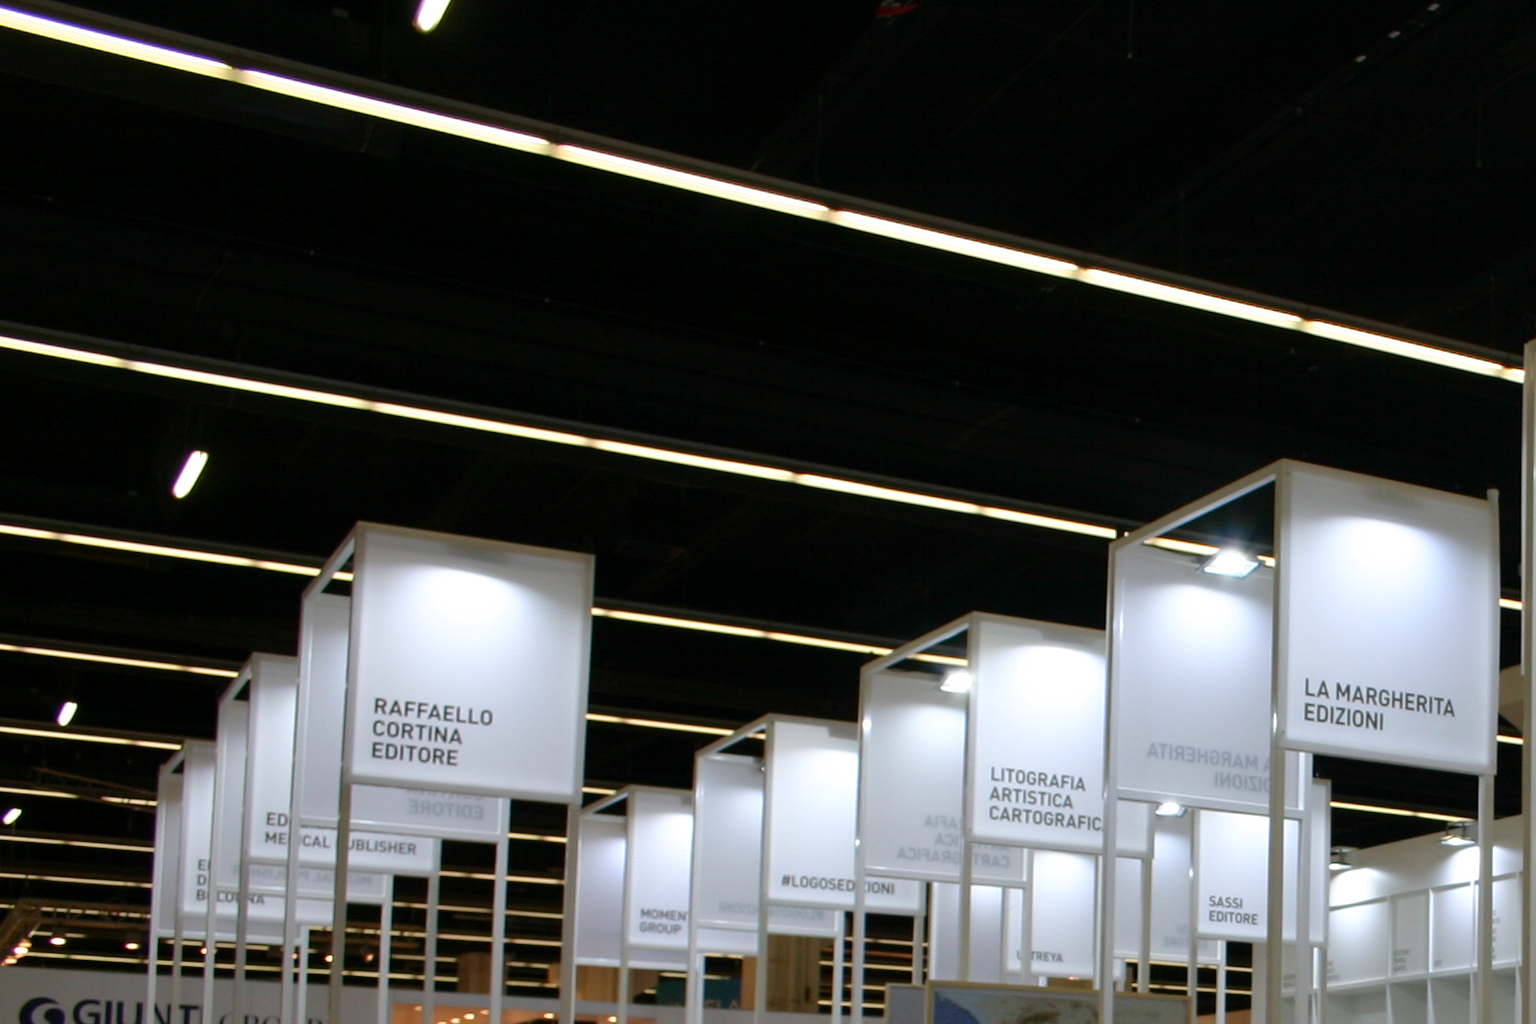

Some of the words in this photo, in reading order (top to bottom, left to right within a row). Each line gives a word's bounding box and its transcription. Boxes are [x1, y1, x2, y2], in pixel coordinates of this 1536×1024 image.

[1304, 678, 1330, 700] LA
[1335, 682, 1456, 718] MARGHERITA
[374, 697, 494, 726] RAFFAELLO
[1304, 703, 1385, 732] EDIZIONI
[372, 720, 463, 745] CORTINA
[371, 742, 459, 767] EDITORE
[990, 766, 1086, 792] LITOGRAFIA
[989, 787, 1074, 810] ARTISTICA
[988, 805, 1104, 832] CARTOGRAFIC
[264, 832, 331, 849] MECAL
[348, 838, 418, 855] UBLISHER
[781, 874, 896, 896] #LOGOSEDIONI
[1208, 895, 1243, 910] SASSI
[640, 908, 689, 921] MOMEN
[1208, 910, 1259, 926] EDITORE
[639, 921, 682, 934] GROUP
[1016, 950, 1063, 963] UTREYA
